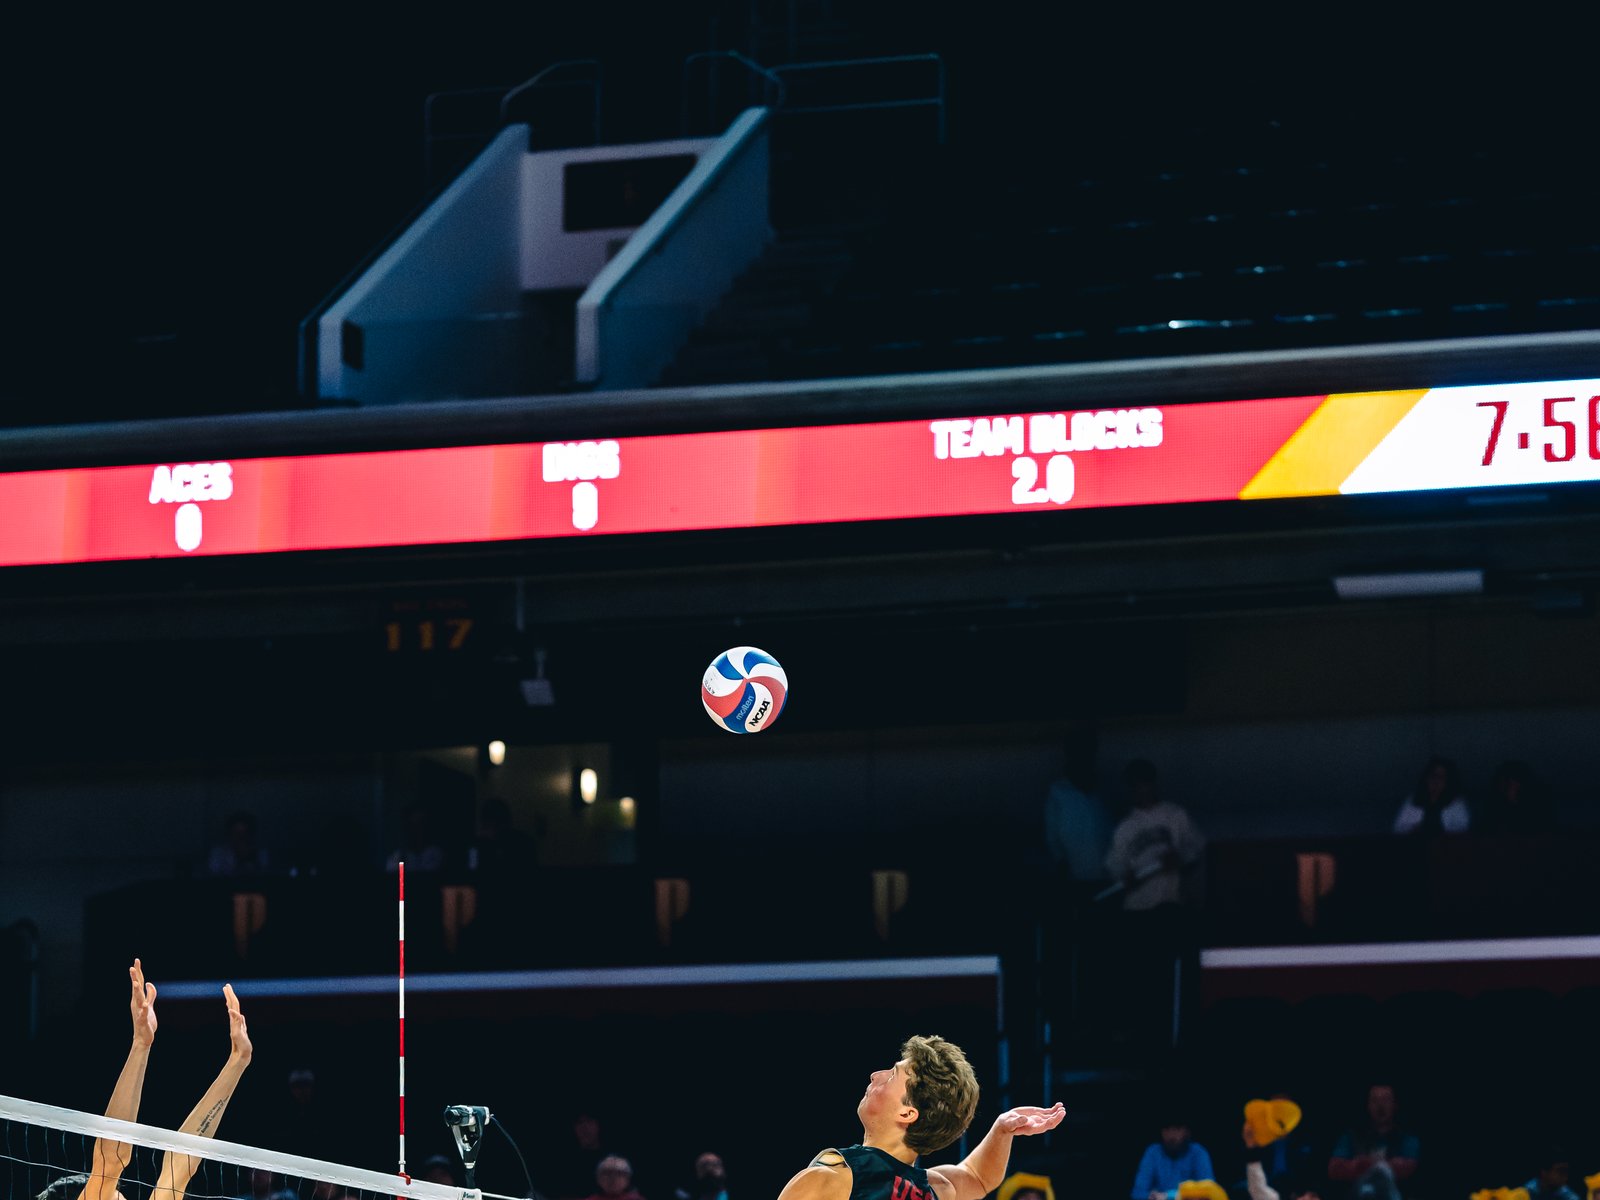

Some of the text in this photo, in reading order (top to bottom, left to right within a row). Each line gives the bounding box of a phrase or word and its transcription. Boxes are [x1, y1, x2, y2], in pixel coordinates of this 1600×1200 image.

[930, 408, 1163, 459] TEAM BLOCKS
[149, 462, 234, 504] ACES
[749, 701, 770, 726] NCAA
